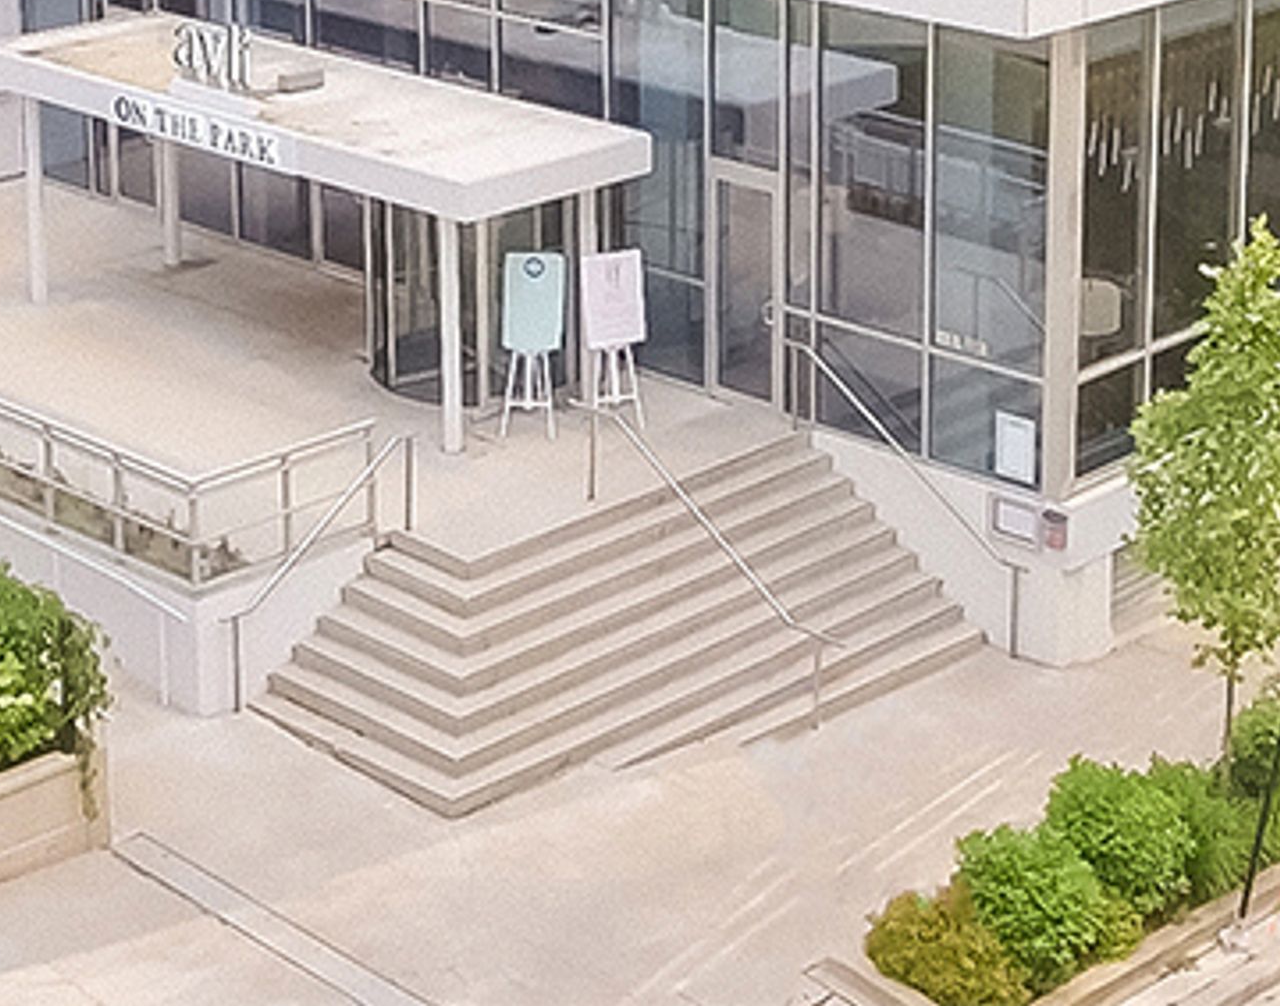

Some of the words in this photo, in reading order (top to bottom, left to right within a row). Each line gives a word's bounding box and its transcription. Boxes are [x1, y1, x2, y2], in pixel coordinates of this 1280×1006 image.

[173, 22, 252, 90] avli
[114, 96, 148, 127] ON
[153, 107, 202, 144] THE
[210, 123, 277, 165] PARK
